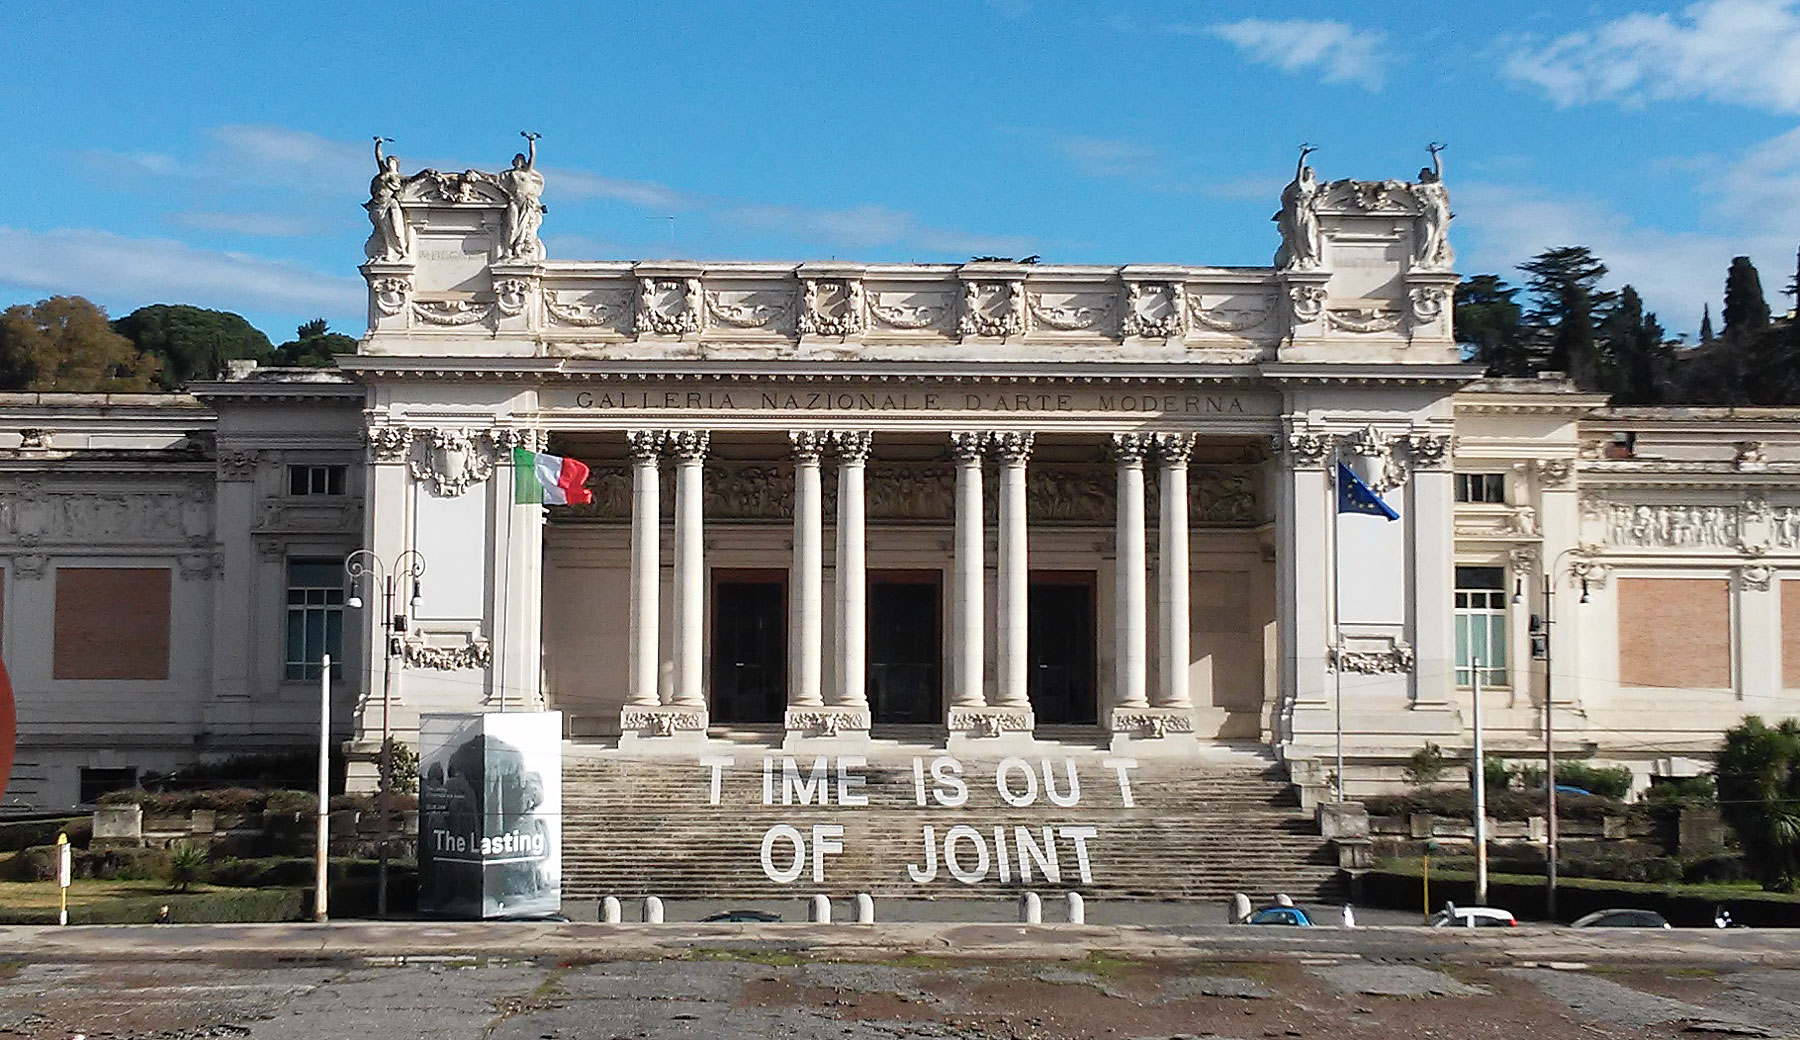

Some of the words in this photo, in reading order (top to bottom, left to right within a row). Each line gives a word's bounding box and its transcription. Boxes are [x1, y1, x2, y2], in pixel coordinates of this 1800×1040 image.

[576, 392, 736, 409] GALLERIA
[761, 392, 941, 411] NAZIONALE
[965, 393, 1073, 412] D'ARTE
[1099, 395, 1244, 413] MODERNA
[700, 756, 869, 806] TIME
[912, 756, 969, 807] IS
[433, 829, 466, 852] The
[470, 829, 545, 855] Lasting
[760, 825, 845, 884] OF
[907, 825, 1098, 884] JOINT
